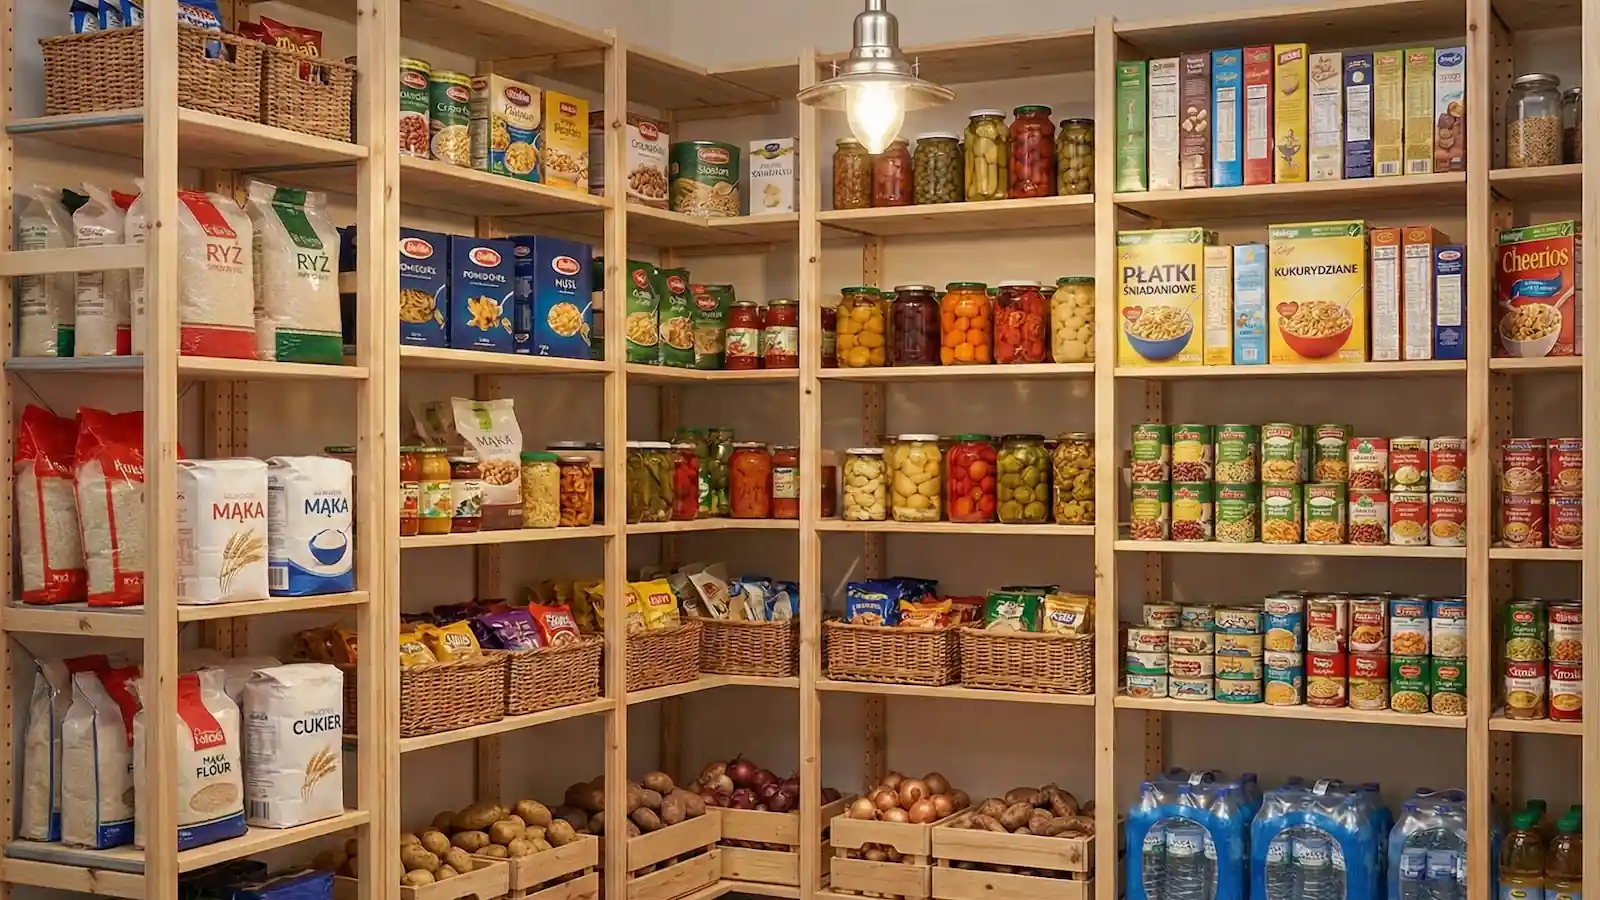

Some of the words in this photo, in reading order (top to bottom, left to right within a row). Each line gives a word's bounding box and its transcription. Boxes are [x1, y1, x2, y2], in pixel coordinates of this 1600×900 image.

[206, 242, 244, 265] RYŻ
[297, 251, 331, 273] RYŻ
[1502, 246, 1569, 273] Cheerios
[1123, 264, 1196, 283] PŁATKI
[1274, 264, 1358, 277] KUKURYDZIANE
[1123, 284, 1197, 296] ŚNIADANIOWE
[212, 502, 265, 523] MĄKA
[304, 497, 349, 518] MĄKA
[293, 714, 342, 735] CUKIER
[196, 762, 232, 779] FLOUR
